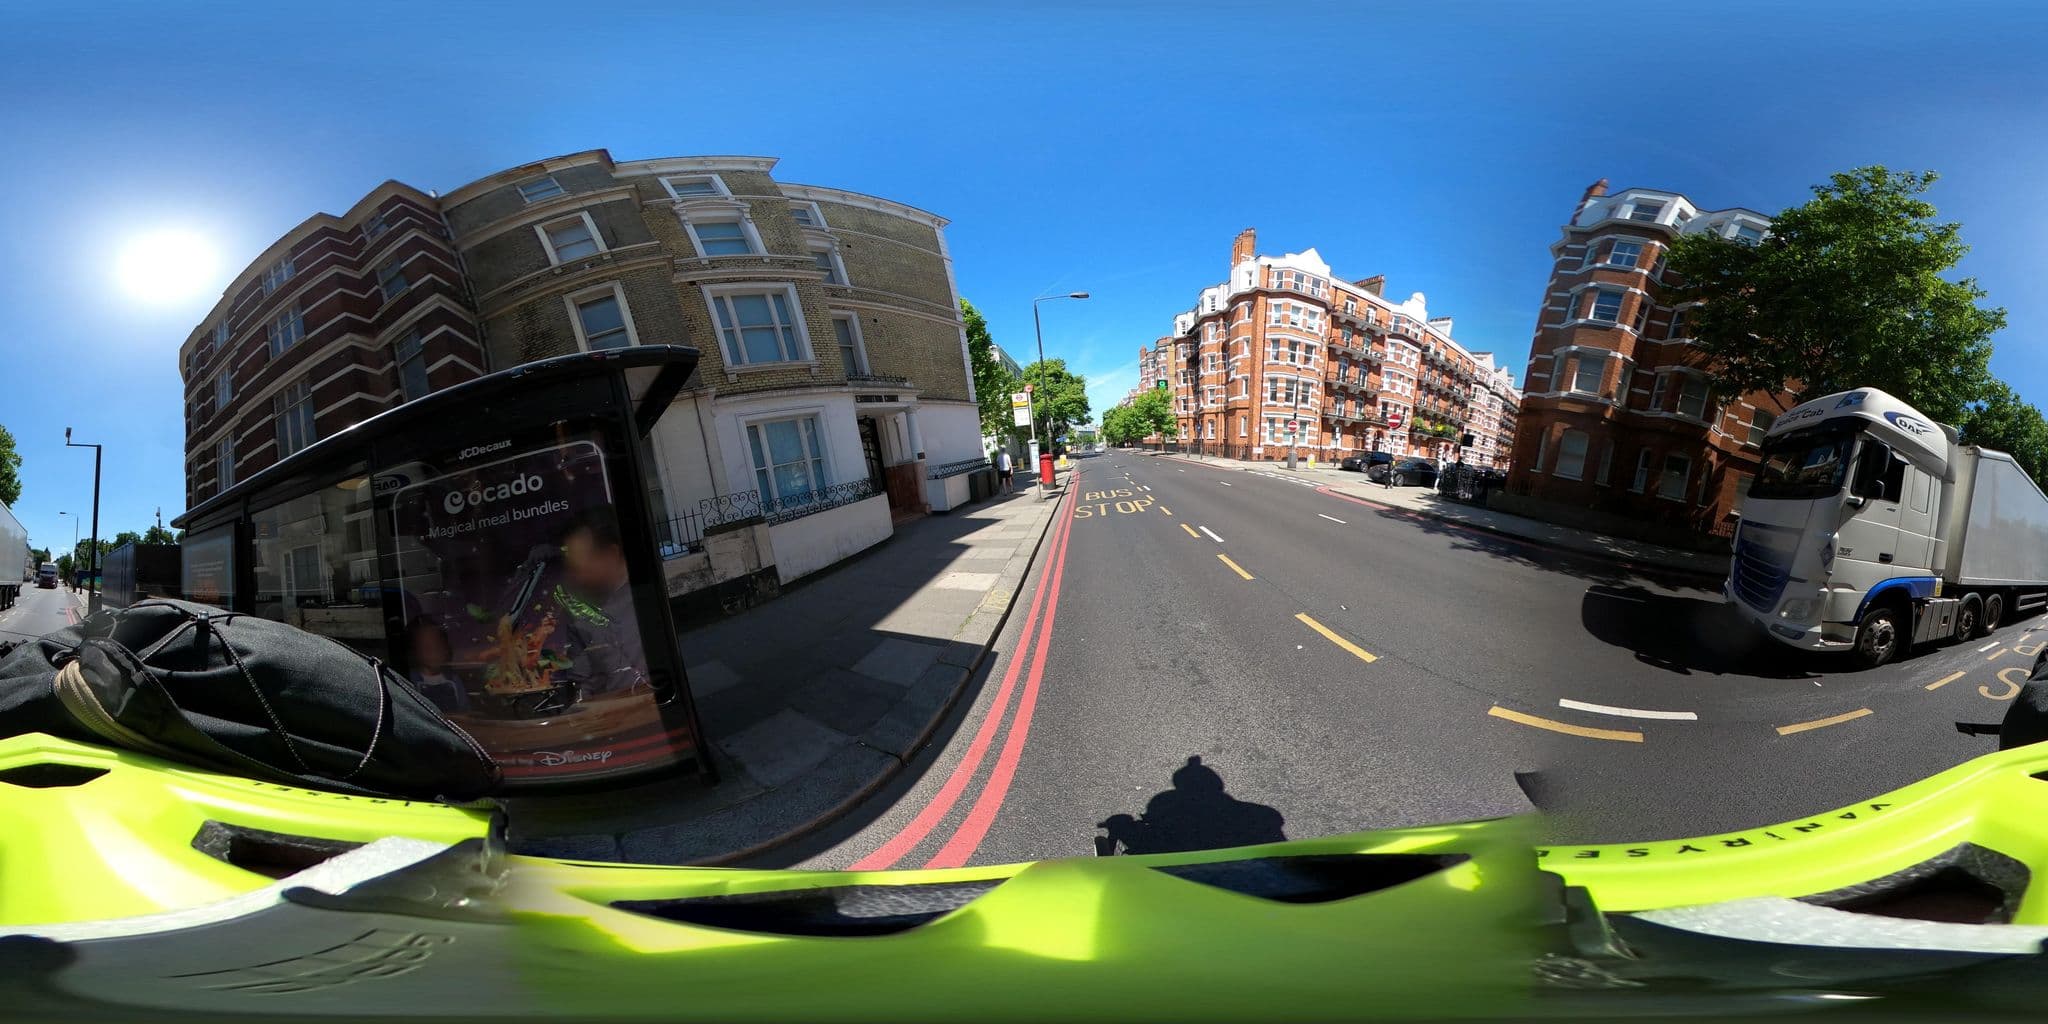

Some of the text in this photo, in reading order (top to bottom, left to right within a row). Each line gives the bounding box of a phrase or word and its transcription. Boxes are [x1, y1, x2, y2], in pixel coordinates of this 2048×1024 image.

[1897, 418, 1924, 436] DAF
[458, 439, 512, 460] JCDecaux
[467, 473, 544, 506] ocado
[1085, 488, 1133, 501] BUS
[428, 499, 569, 538] Magical meal bundles
[1073, 499, 1153, 518] STOP
